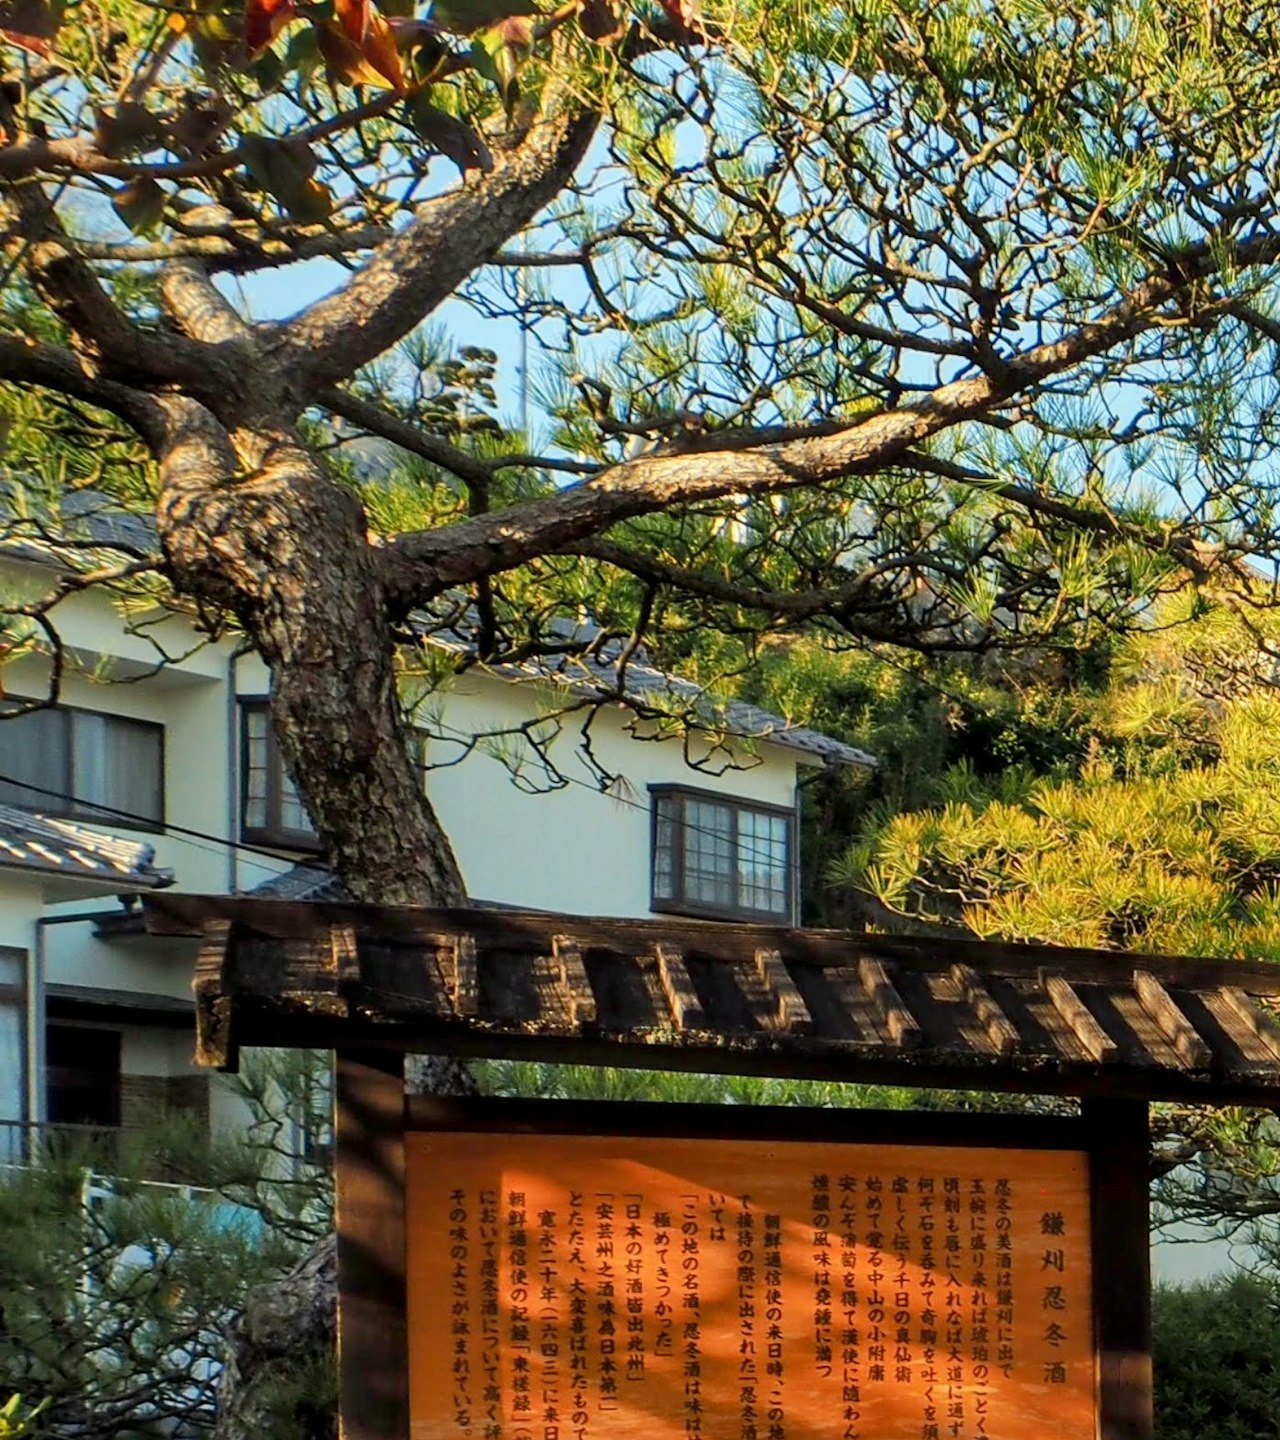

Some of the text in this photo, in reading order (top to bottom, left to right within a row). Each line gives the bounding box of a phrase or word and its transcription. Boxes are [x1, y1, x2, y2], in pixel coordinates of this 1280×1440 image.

[709, 1194, 727, 1242] いては
[652, 1211, 673, 1358] 極めてきつかった」
